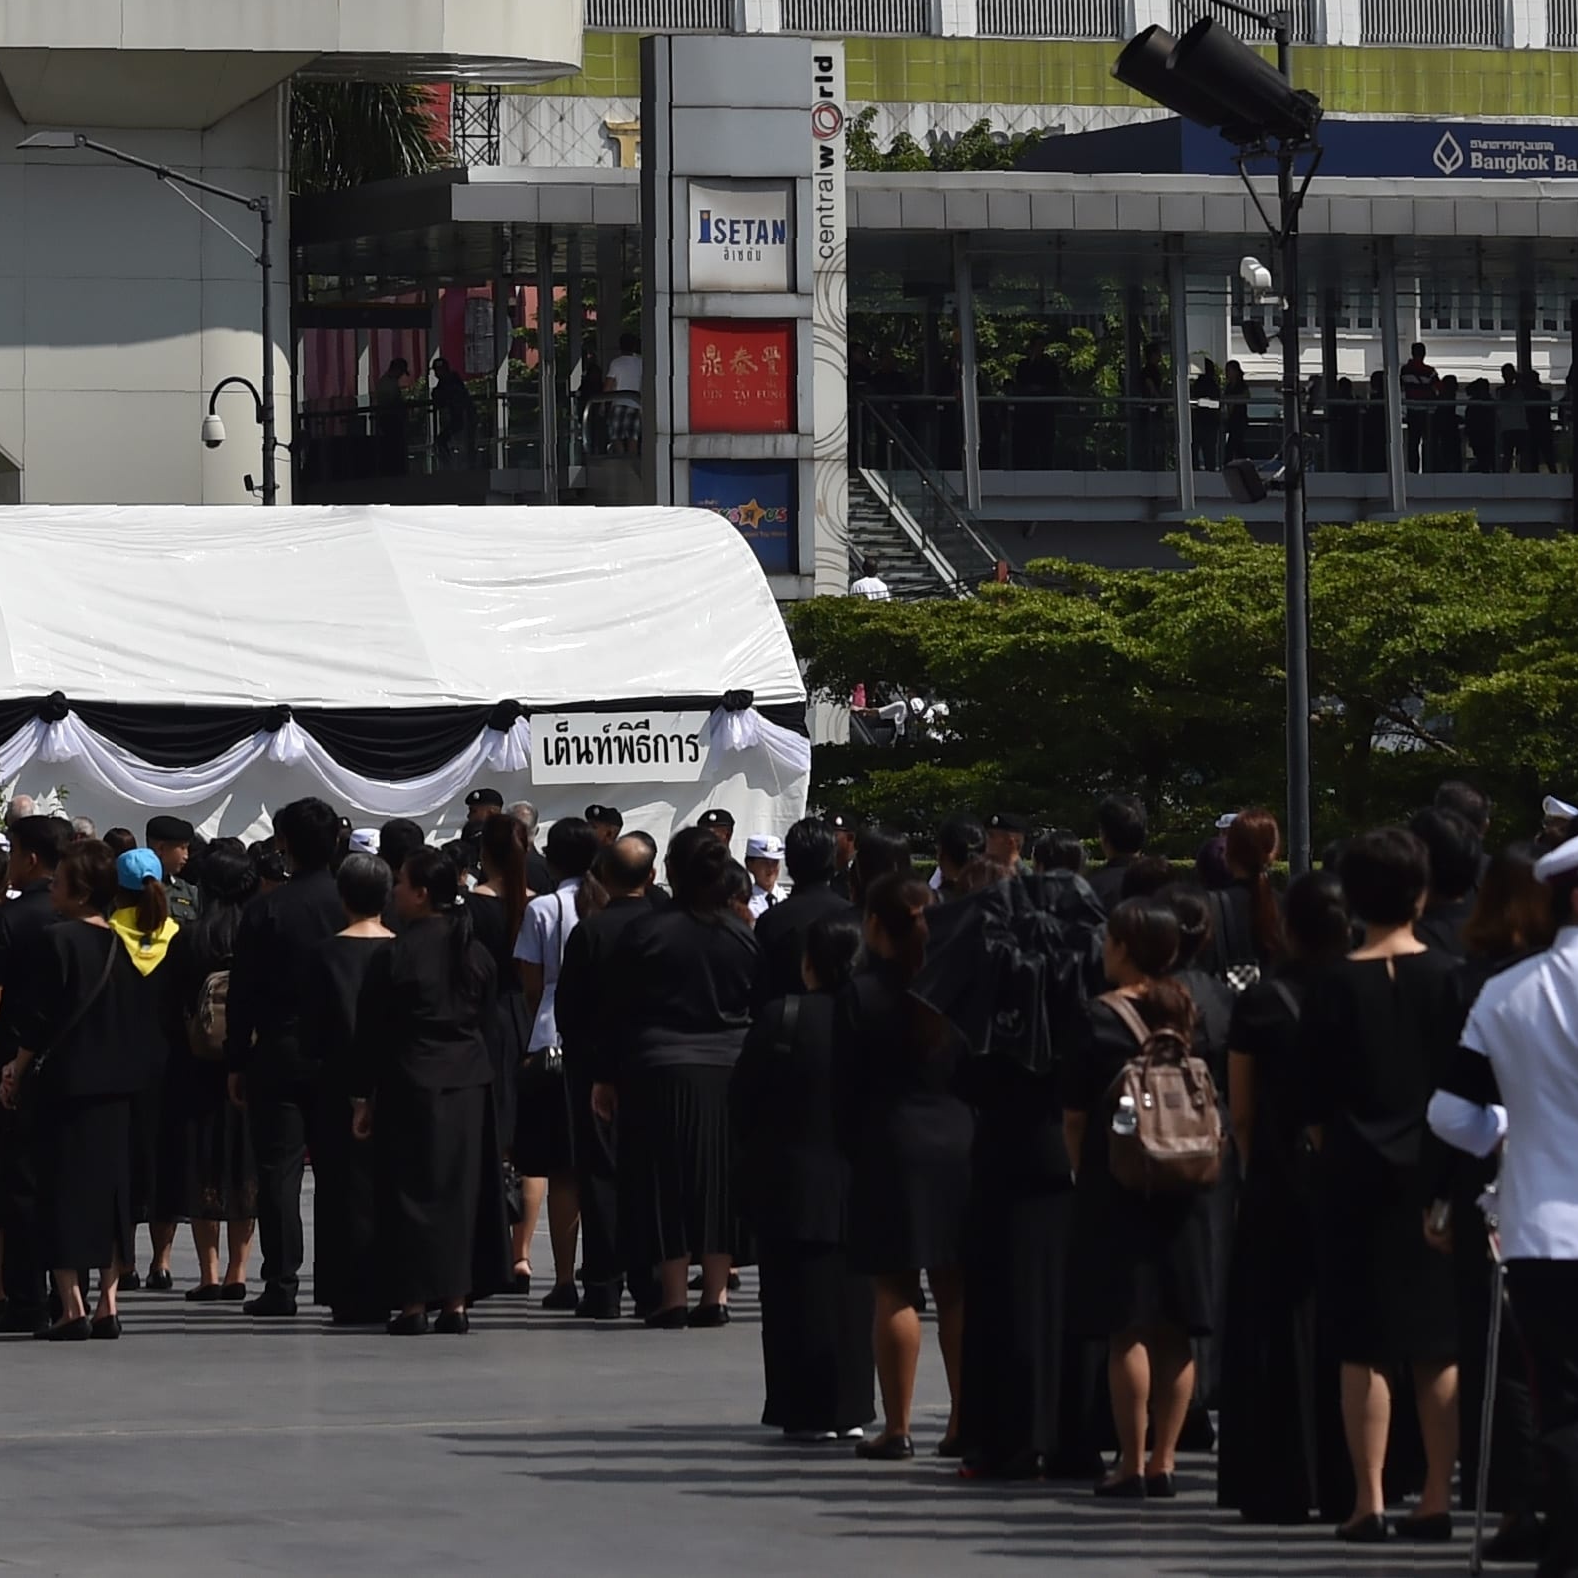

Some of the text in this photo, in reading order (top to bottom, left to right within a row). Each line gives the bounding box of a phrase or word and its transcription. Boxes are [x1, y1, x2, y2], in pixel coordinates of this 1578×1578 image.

[1470, 151, 1550, 174] Bangkok
[697, 209, 786, 245] ISETAN
[542, 718, 700, 766] เต็นท์พิธีการ
